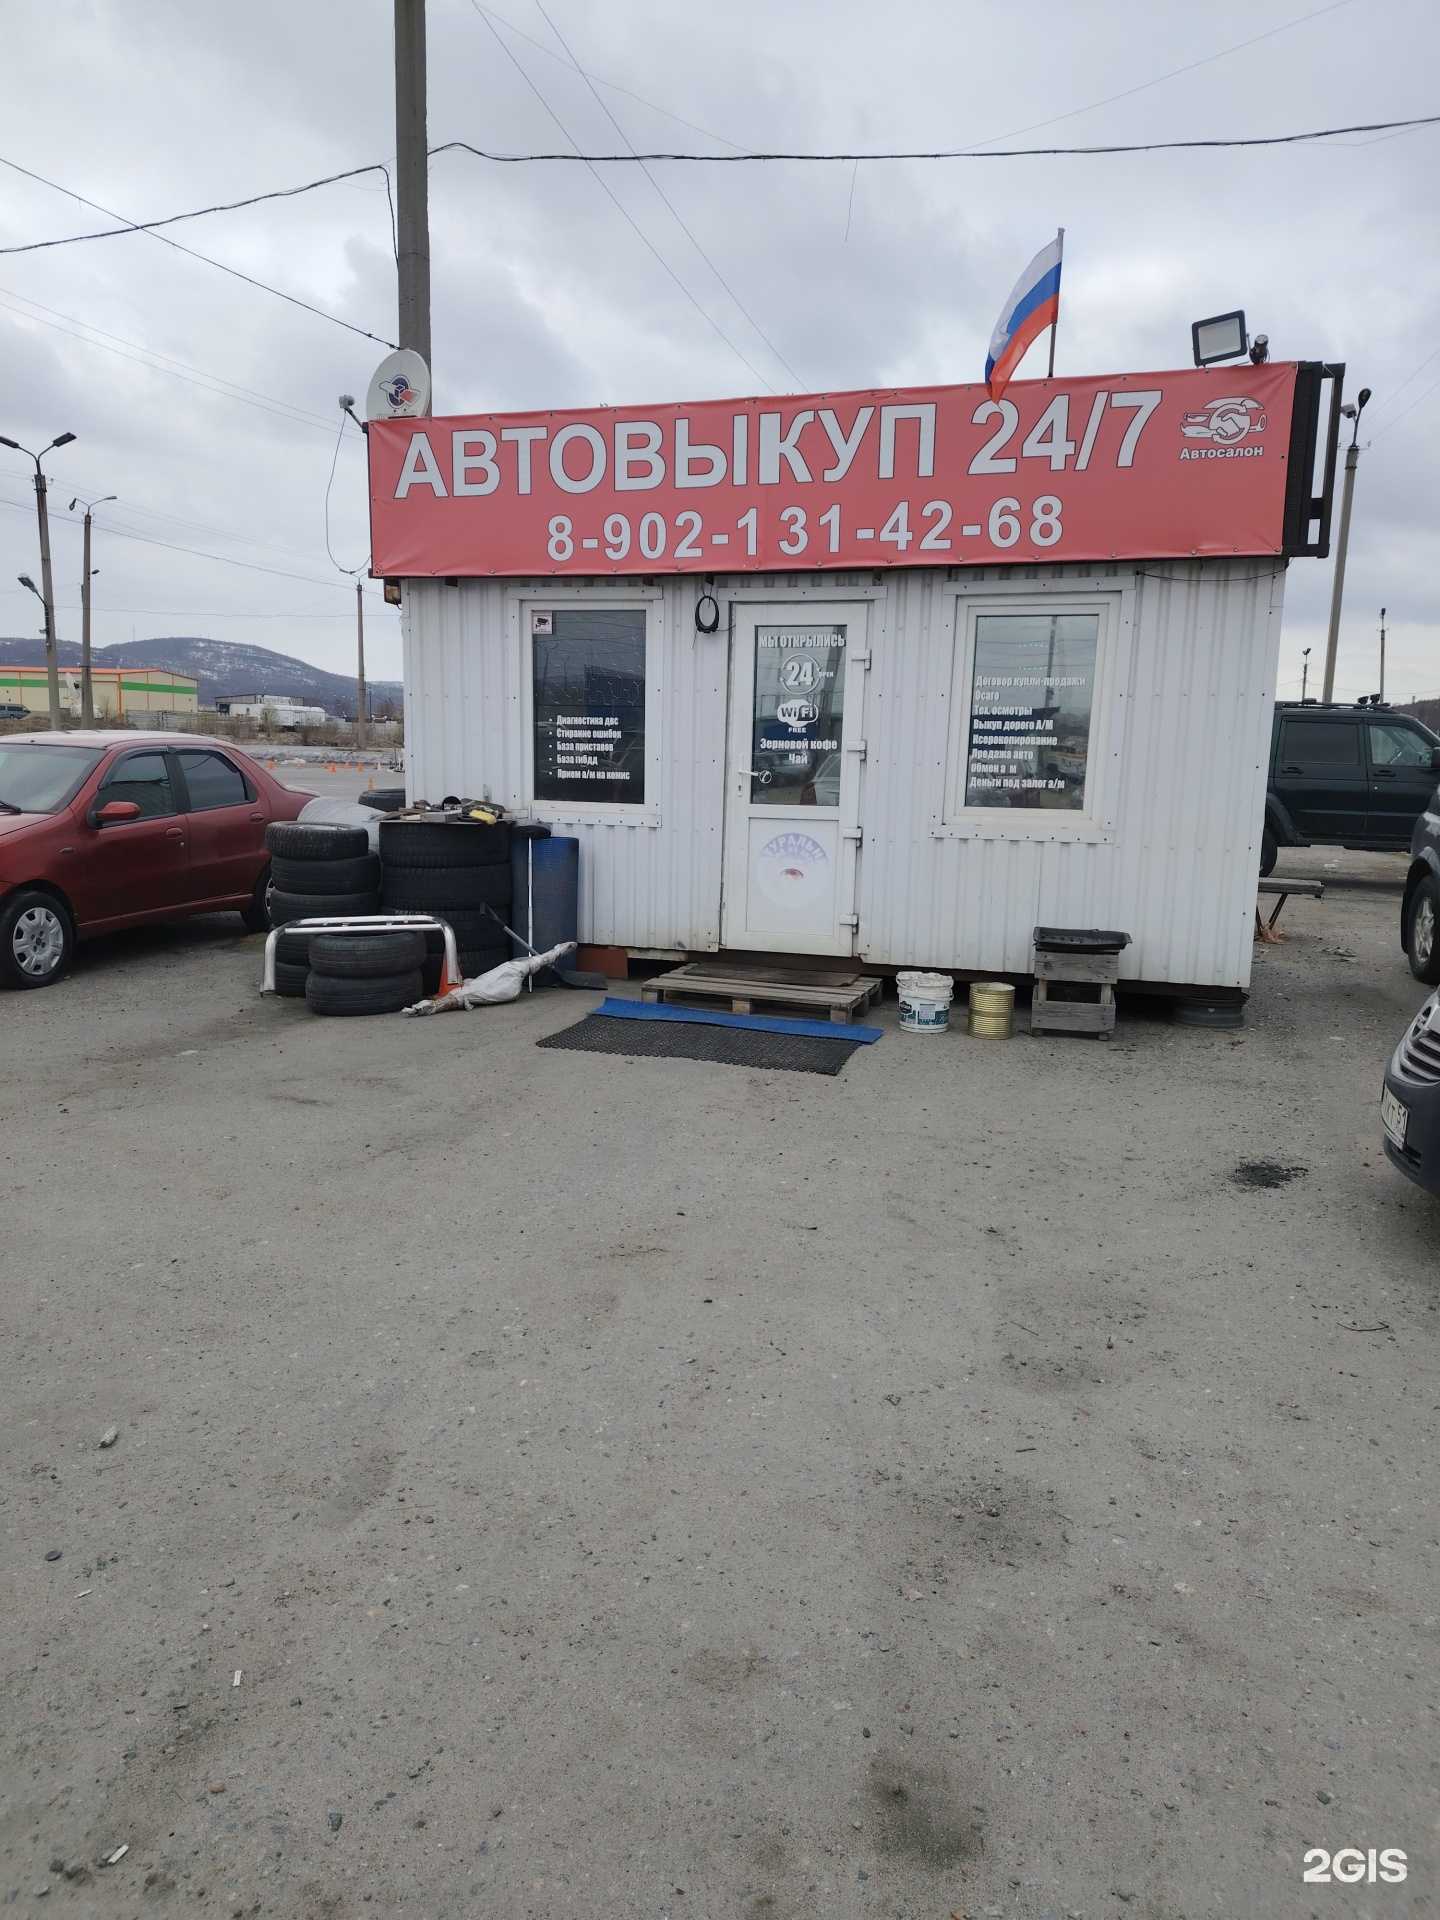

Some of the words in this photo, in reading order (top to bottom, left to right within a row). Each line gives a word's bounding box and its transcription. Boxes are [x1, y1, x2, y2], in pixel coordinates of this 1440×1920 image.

[393, 403, 937, 499] АВТОВЫКУП
[967, 389, 1163, 475] 24/7
[1179, 444, 1264, 460] Автосалон
[546, 495, 1064, 561] 8-902-131-42-68
[780, 634, 845, 648] ОТКРЫЛИСЬ
[785, 661, 814, 686] 24
[556, 715, 604, 726] Диагностика
[556, 741, 575, 751] База
[760, 737, 809, 751] Зерновой
[810, 738, 838, 751] кофе
[972, 734, 1058, 746] Ксерокопирование
[556, 754, 575, 764] База
[788, 751, 808, 765] Чай
[1013, 751, 1034, 759] авто
[1002, 779, 1020, 789] под
